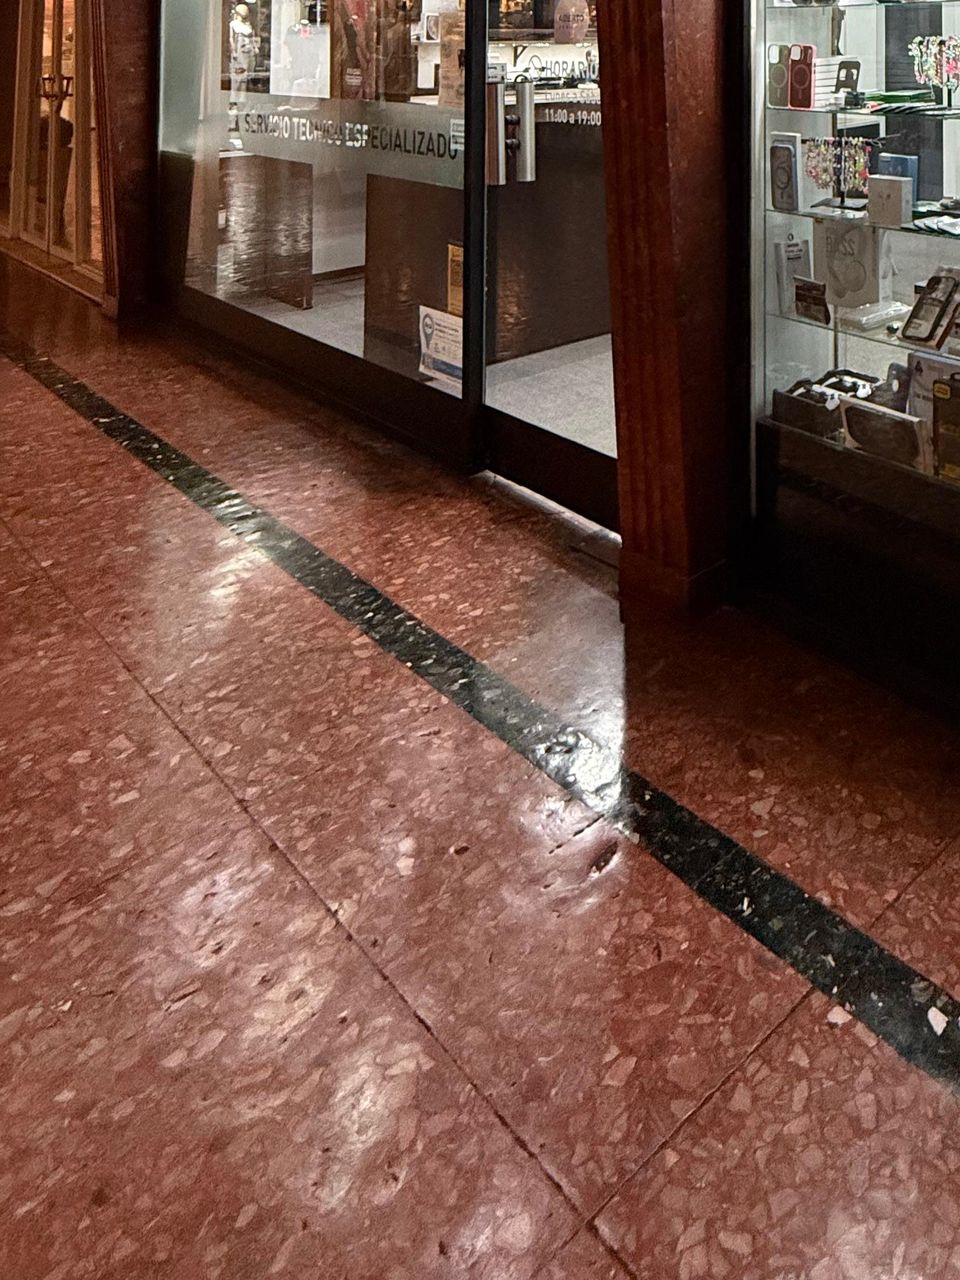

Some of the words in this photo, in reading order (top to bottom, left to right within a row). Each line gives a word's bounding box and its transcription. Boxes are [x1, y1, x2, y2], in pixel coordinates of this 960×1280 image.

[545, 60, 598, 80] HORARIO
[545, 108, 567, 124] 11:00
[569, 112, 575, 125] a
[577, 110, 602, 127] 19:00
[244, 113, 290, 139] SERVICIO
[292, 116, 343, 146] TECNICO
